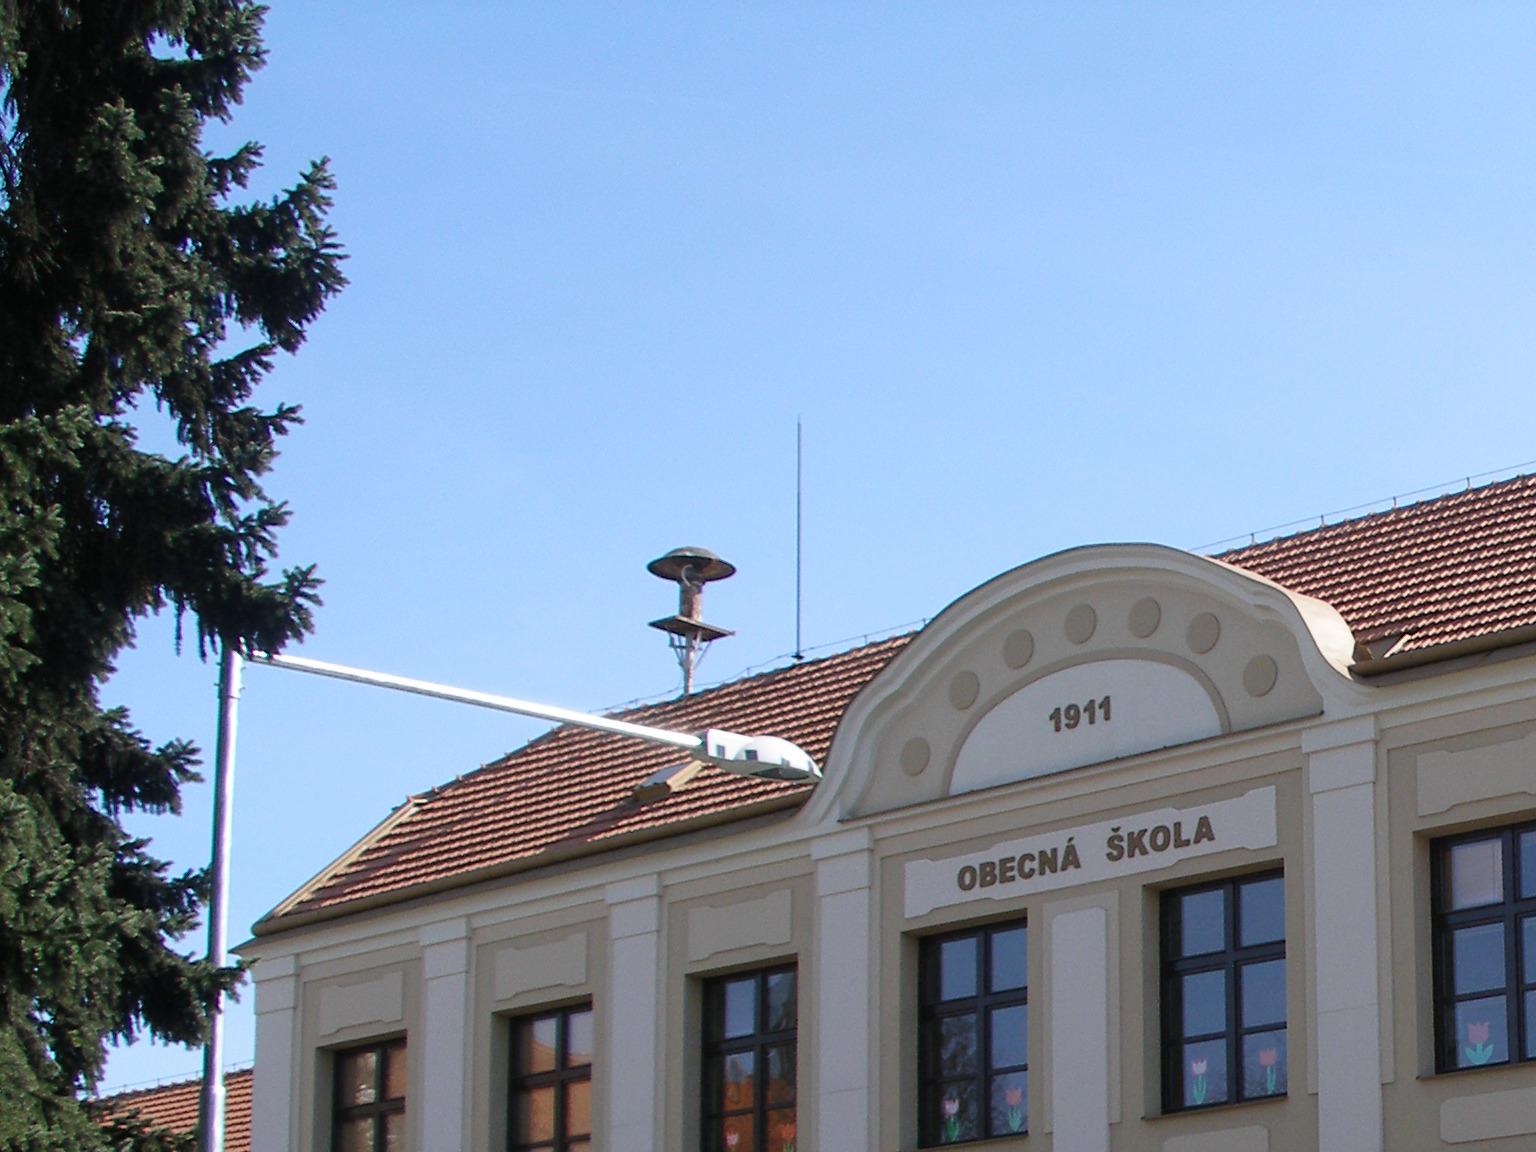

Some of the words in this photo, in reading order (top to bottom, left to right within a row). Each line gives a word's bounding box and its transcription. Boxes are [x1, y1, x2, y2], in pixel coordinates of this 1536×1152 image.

[1049, 696, 1112, 732] 1911
[957, 836, 1081, 891] OBECNÁ
[1106, 815, 1215, 862] ŠKOLA
